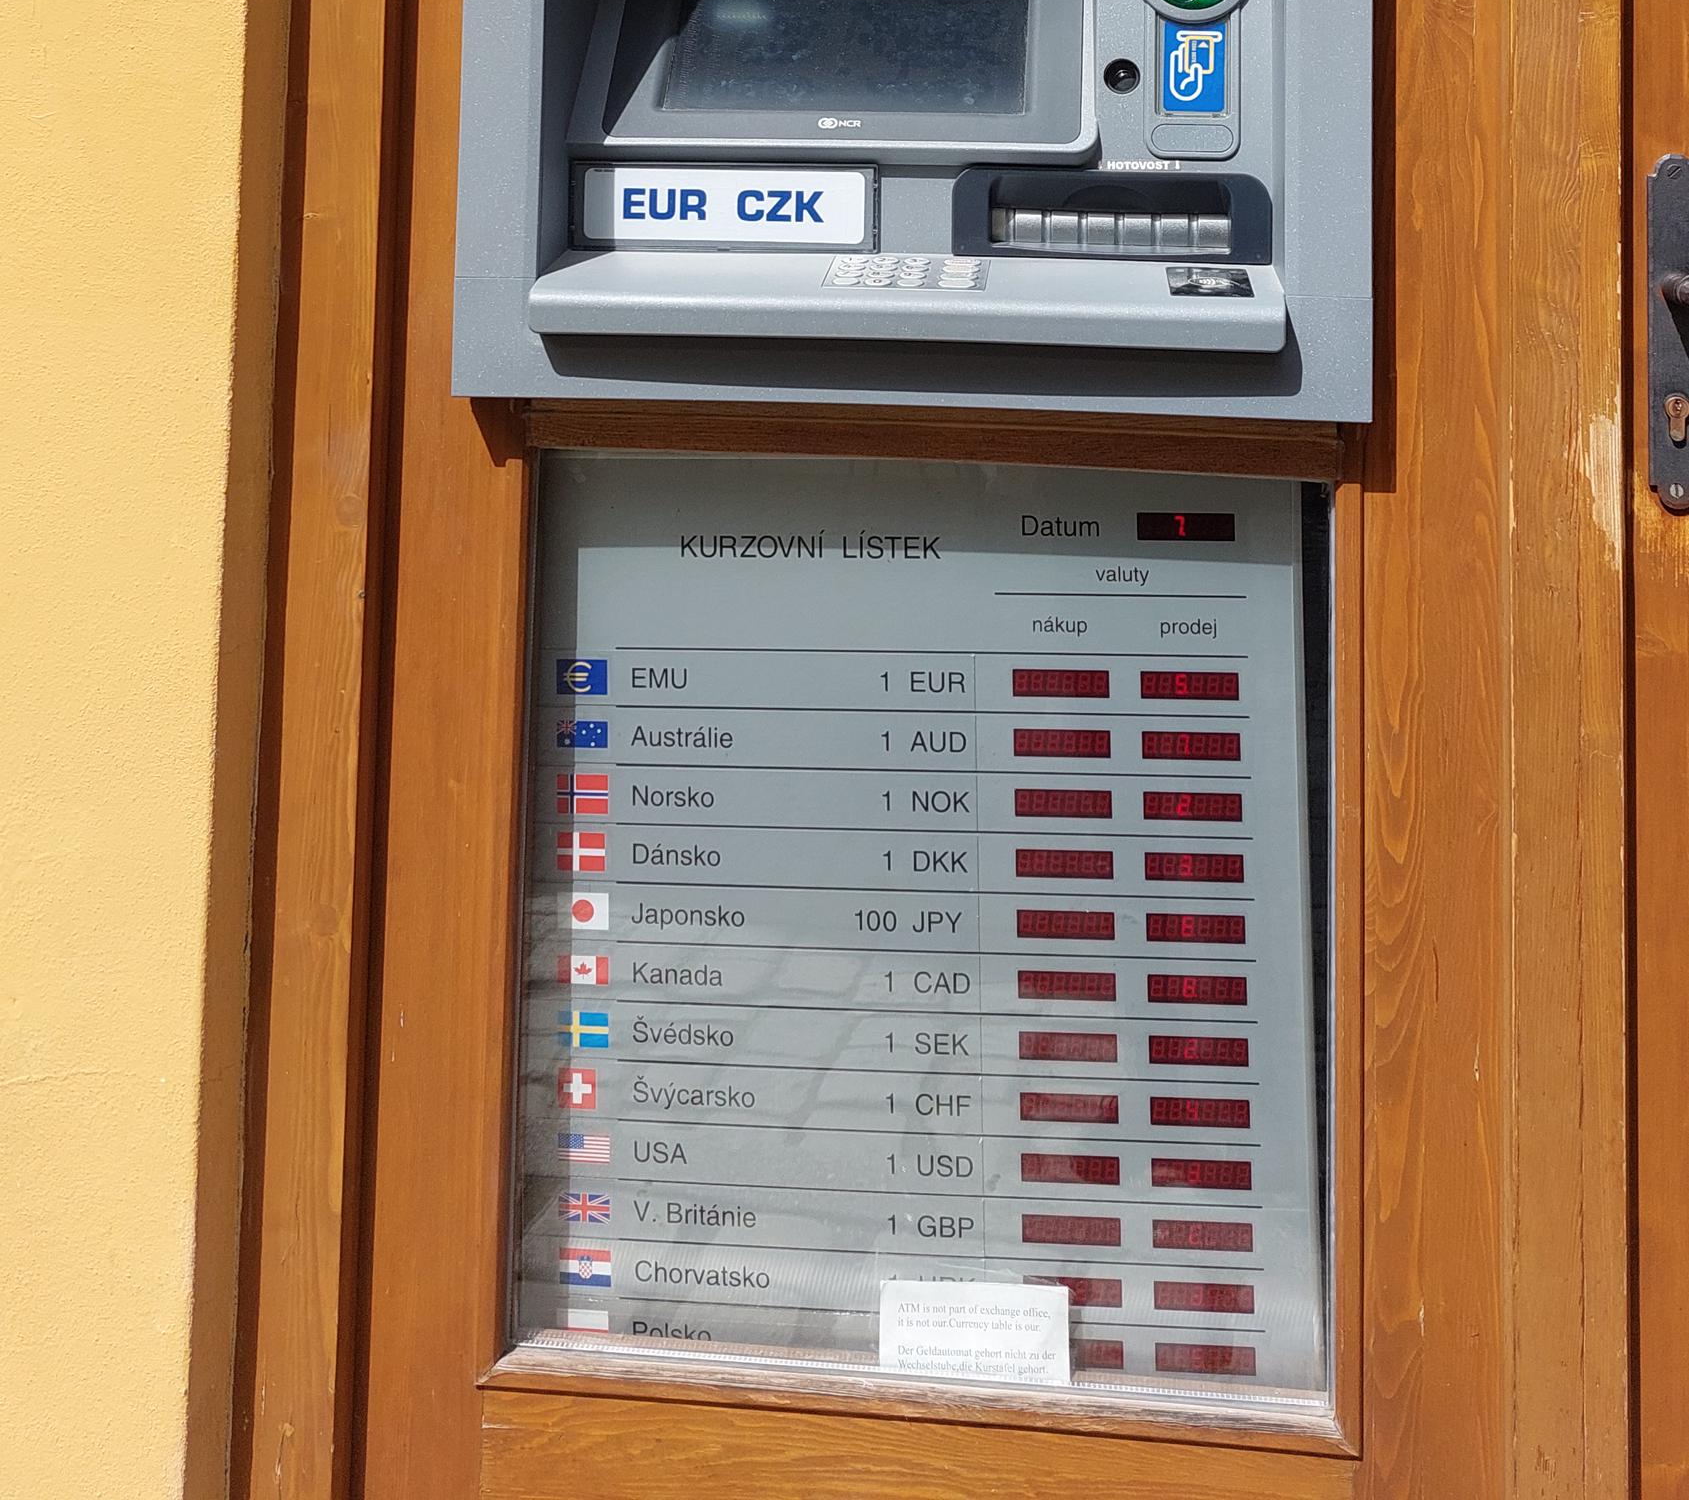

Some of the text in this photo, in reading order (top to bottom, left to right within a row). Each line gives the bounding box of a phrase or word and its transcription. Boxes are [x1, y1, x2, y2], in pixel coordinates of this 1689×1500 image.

[838, 119, 862, 128] NCR
[1107, 160, 1171, 170] HOTOVOST
[623, 188, 824, 223] EUR CZK
[1021, 515, 1100, 537] Datum
[680, 530, 941, 559] KURZOVNÍ LÍSTEK
[1095, 566, 1149, 586] valuty
[1033, 616, 1217, 638] nákup prodej
[631, 668, 966, 693] EMU 1 EUR
[631, 725, 967, 753] Austrálie 1 AUD
[632, 785, 970, 813] Norsko 1 NOK
[632, 843, 968, 873] Dánsko 1 DKK
[632, 903, 962, 933] Japonsko 100 JPY
[632, 962, 970, 995] Kanada 1 CAD
[632, 1015, 969, 1056] Švédsko 1 SEK
[633, 1076, 972, 1116] Švýcarsko 1 CHF
[633, 1141, 974, 1178] USA 1 USD
[633, 1198, 975, 1239] V. Británie 1 GBP
[634, 1260, 770, 1289] Chorvatsko
[898, 1302, 1051, 1319] ATM is not part of exchange office,
[907, 1317, 913, 1327] is
[916, 1318, 930, 1328] not
[991, 1320, 1013, 1330] table
[1015, 1320, 1023, 1331] is
[633, 1321, 711, 1341] Polsko
[898, 1345, 913, 1356] Der
[916, 1345, 972, 1357] Geldautomat
[1005, 1348, 1027, 1359] nicht
[1029, 1352, 1039, 1360] zu
[1041, 1350, 1056, 1360] der
[975, 1362, 1016, 1373] Kurstafel
